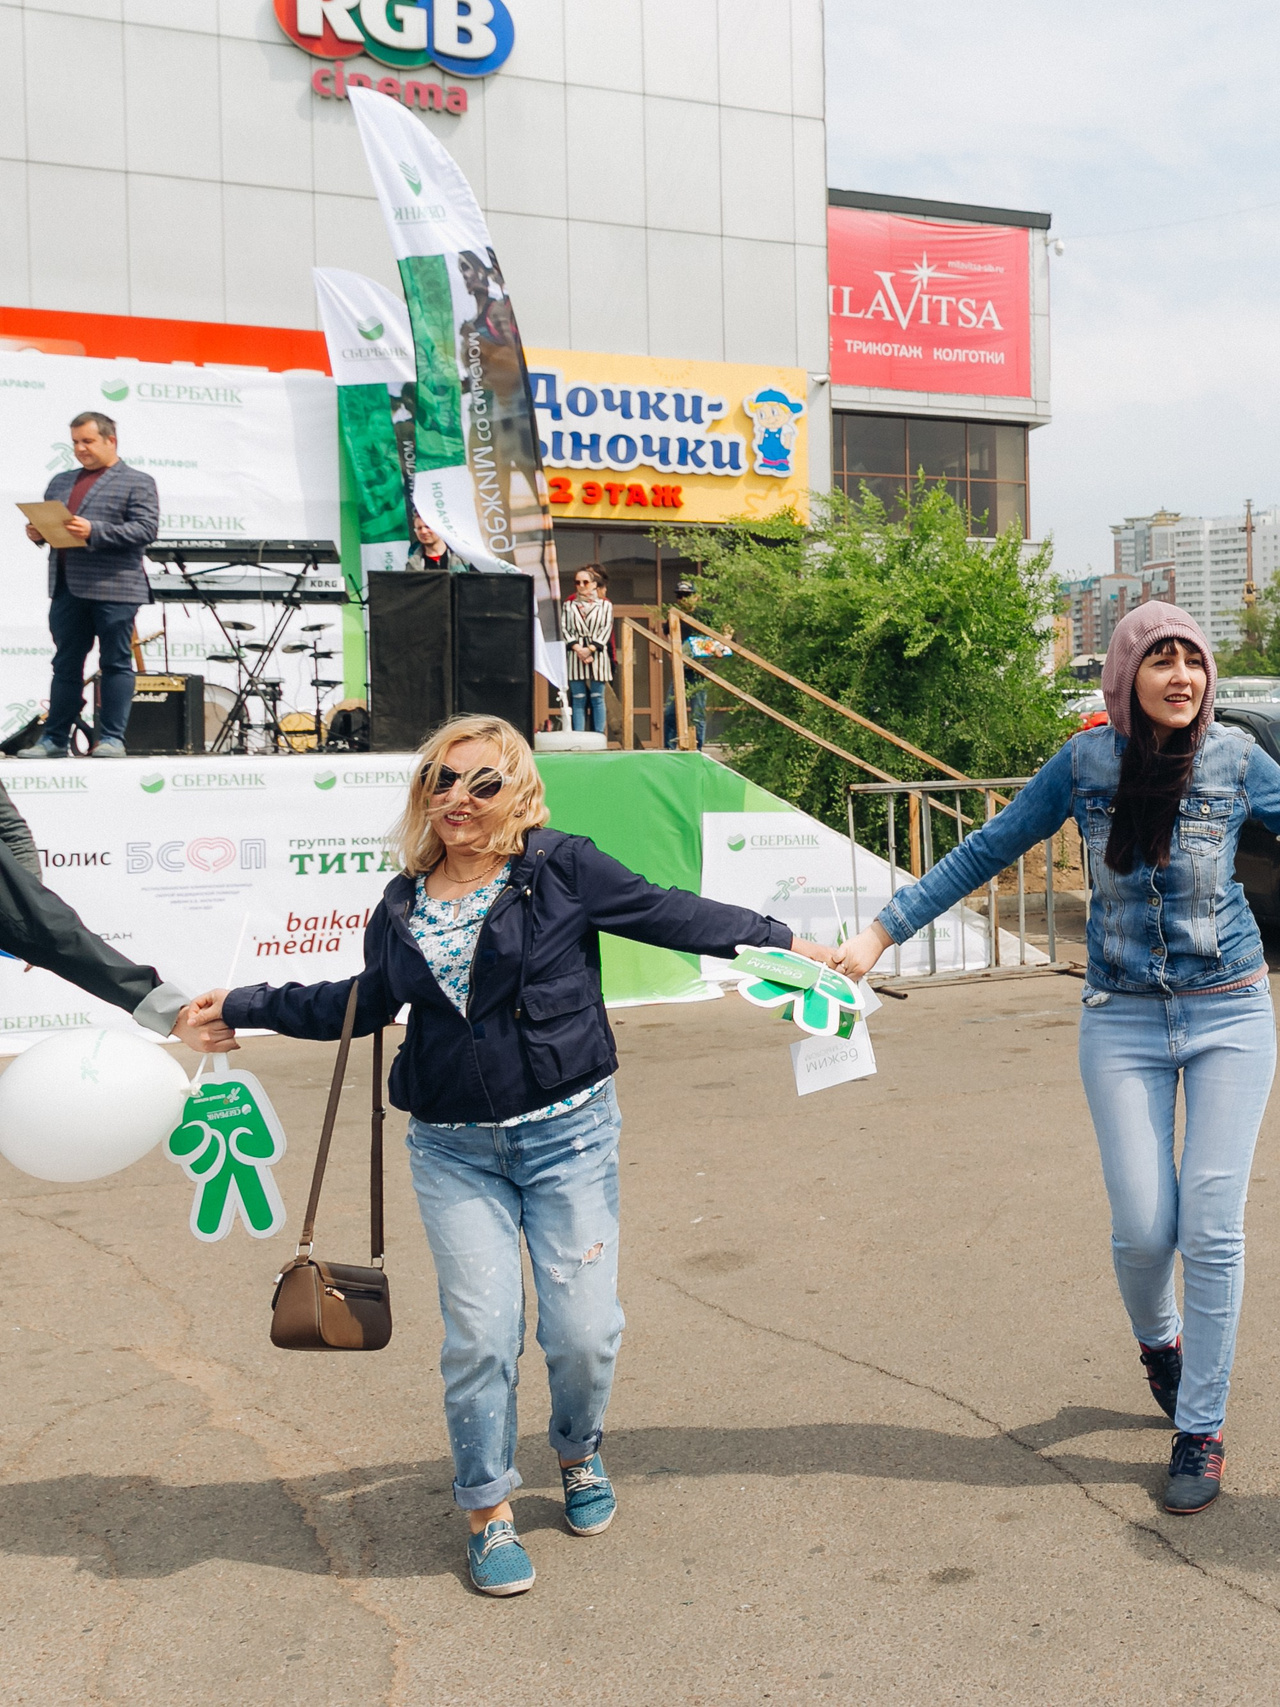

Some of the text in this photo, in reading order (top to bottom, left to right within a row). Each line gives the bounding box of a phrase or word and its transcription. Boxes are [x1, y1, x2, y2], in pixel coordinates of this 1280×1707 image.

[297, 0, 497, 59] RGB
[829, 271, 1004, 331] ILAVITSA
[845, 339, 923, 359] ТРИКОТАЖ
[933, 347, 1005, 365] КОЛГОТКИ
[137, 383, 243, 405] СБЕРБАНК
[529, 372, 723, 425] Дочки-
[539, 431, 742, 471] ыночки
[549, 477, 684, 508] 2 ЭТАЖ
[157, 514, 246, 531] БЕРБАНК
[310, 580, 338, 588] KORG
[0, 775, 89, 790] БЕРБАНК
[172, 772, 267, 788] СБЕРБАНК
[343, 770, 412, 785] СБЕРБАН
[289, 838, 346, 850] группа
[750, 834, 820, 847] СБЕРБАНК
[289, 851, 403, 876] ТИТА
[836, 885, 868, 893] МАРАОН
[287, 908, 370, 933] baikal
[257, 933, 341, 957] media
[805, 1047, 859, 1073] бежим
